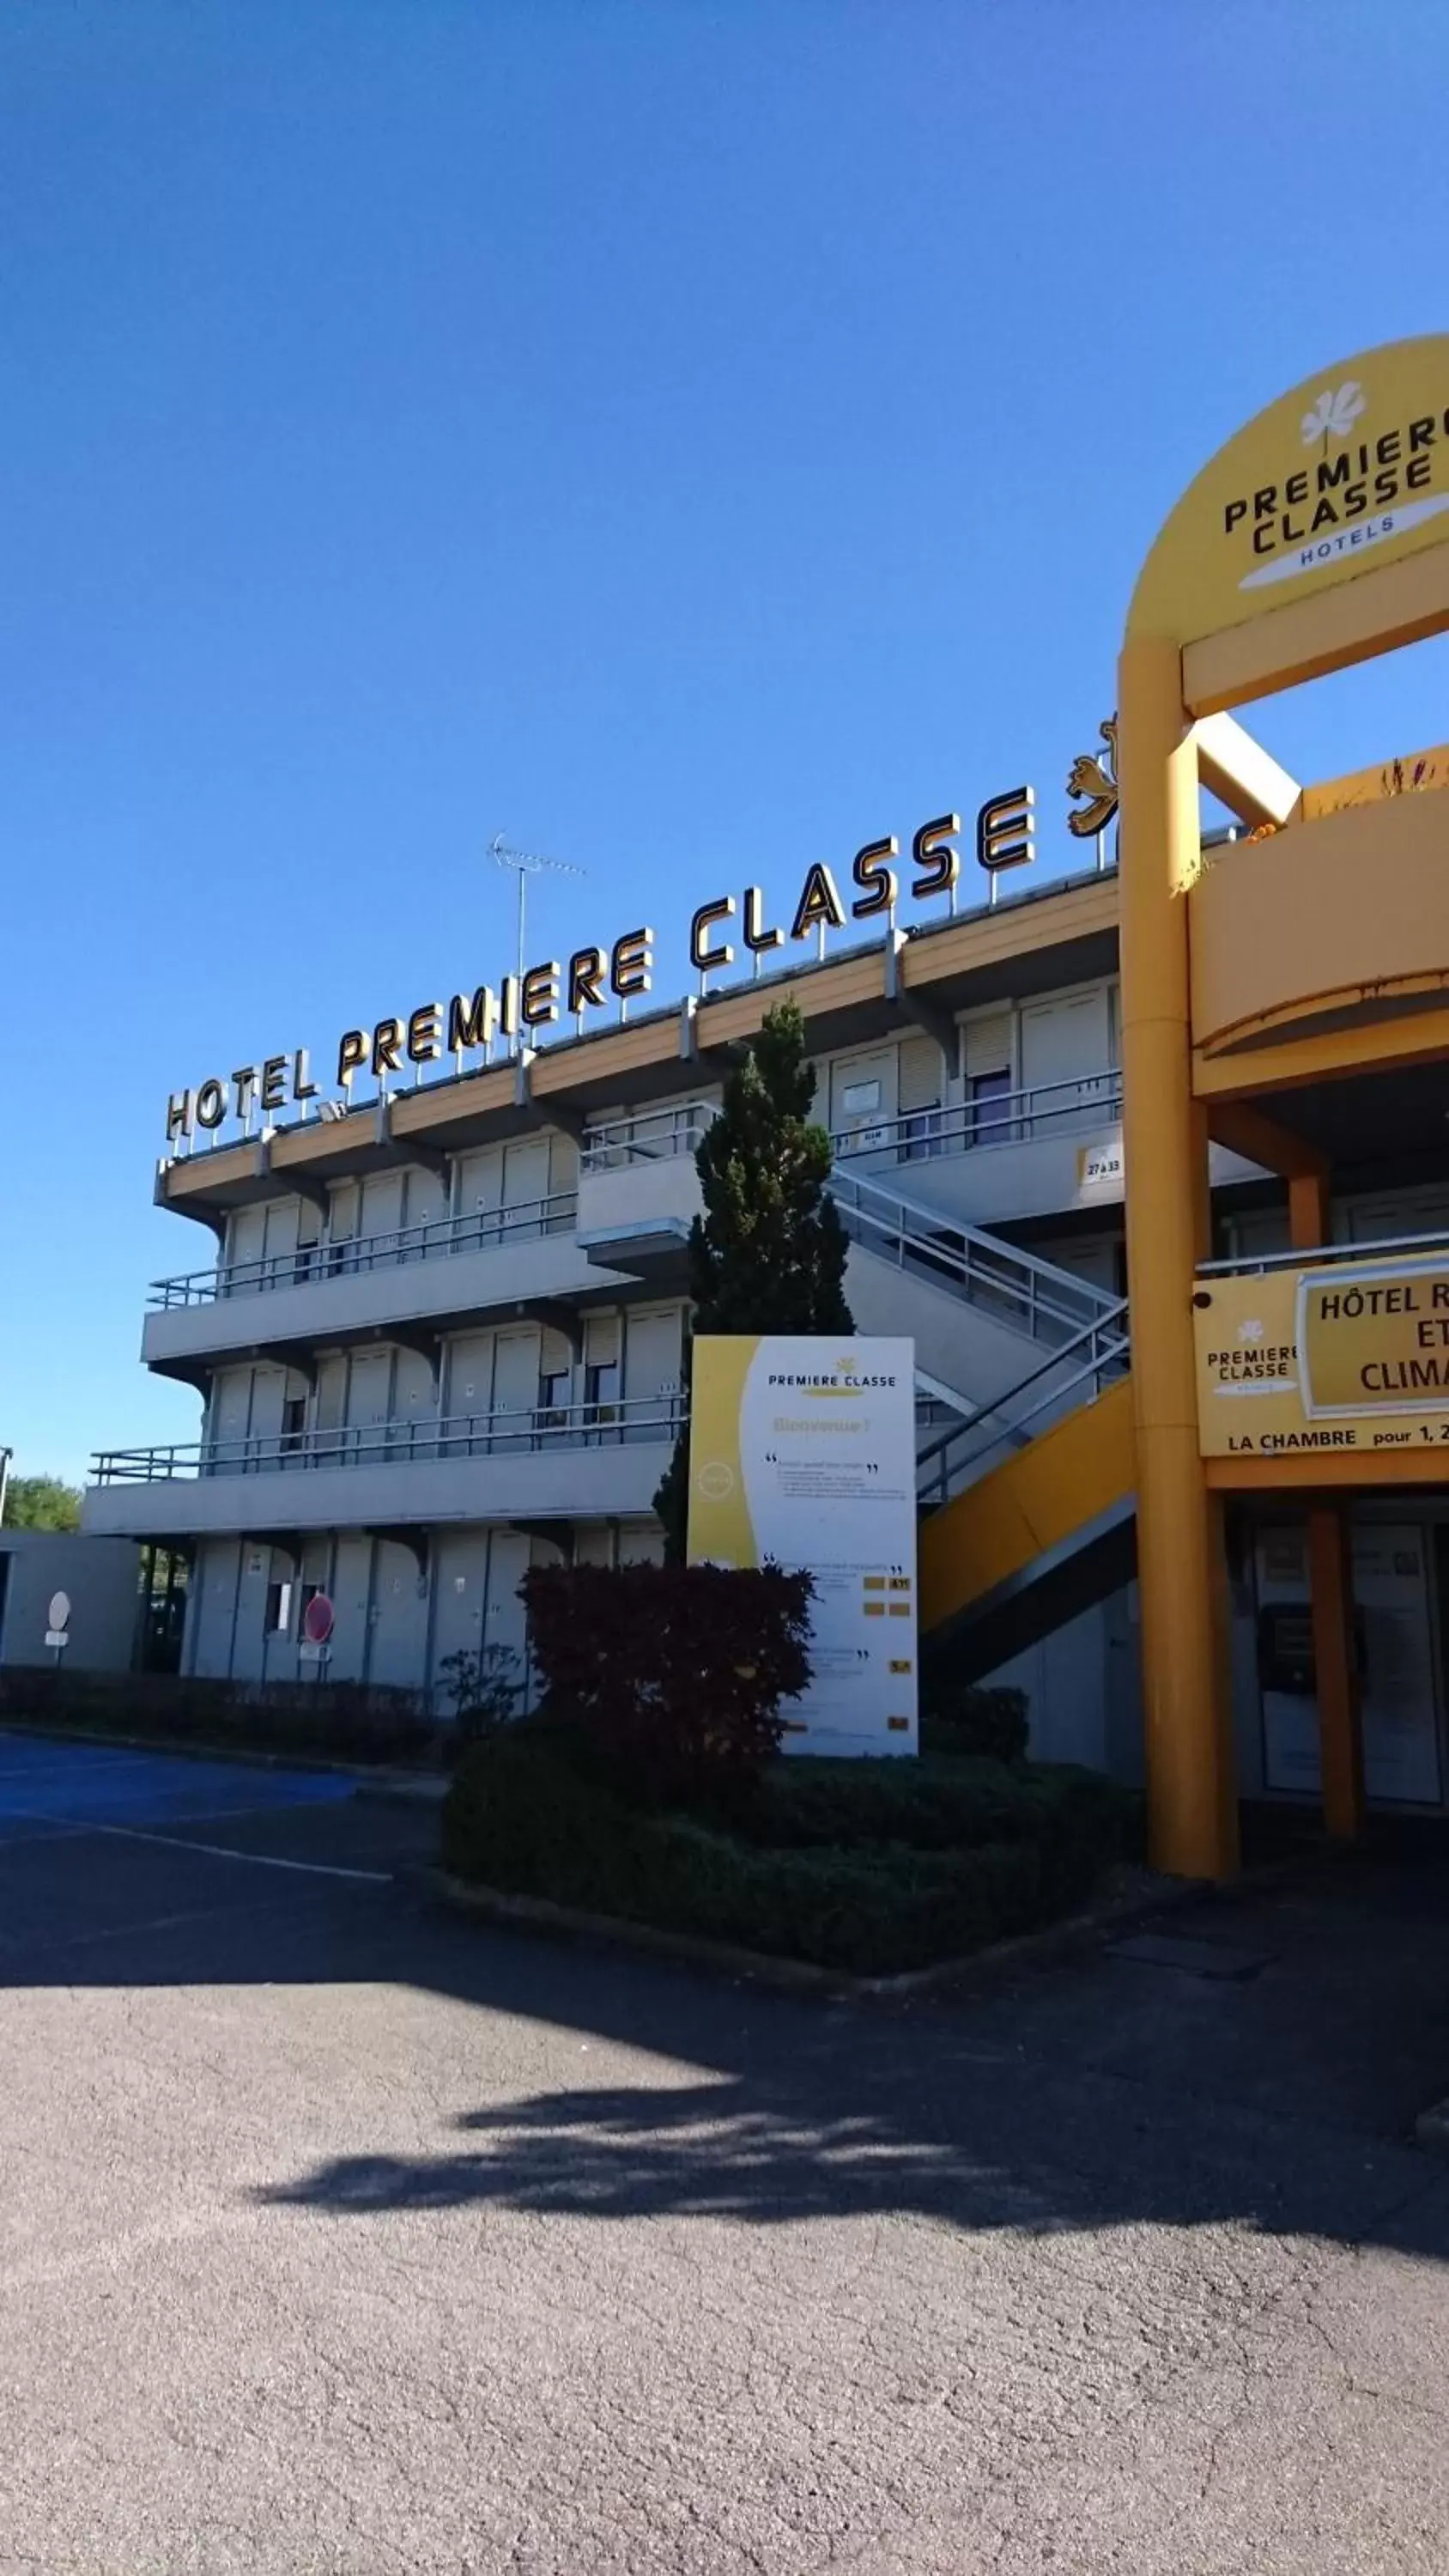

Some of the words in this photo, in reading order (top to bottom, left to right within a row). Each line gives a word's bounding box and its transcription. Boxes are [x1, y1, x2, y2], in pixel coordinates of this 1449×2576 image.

[1224, 408, 1449, 534] PREMIER
[1252, 453, 1432, 555] CLASSE
[1300, 516, 1395, 566] HOTELS
[167, 1048, 319, 1141] HOTEL
[337, 927, 653, 1086] PREMIERE
[690, 785, 1034, 970] CLASSE
[1321, 1286, 1420, 1321] HÔTEL
[768, 1374, 838, 1388] PREMIERE
[844, 1375, 896, 1388] CLASSE
[1219, 1362, 1288, 1381] CLASSE
[1360, 1358, 1449, 1392] CLIM
[1228, 1437, 1253, 1451] LA
[1259, 1429, 1356, 1450] CHAMBRE
[1373, 1431, 1412, 1447] pour
